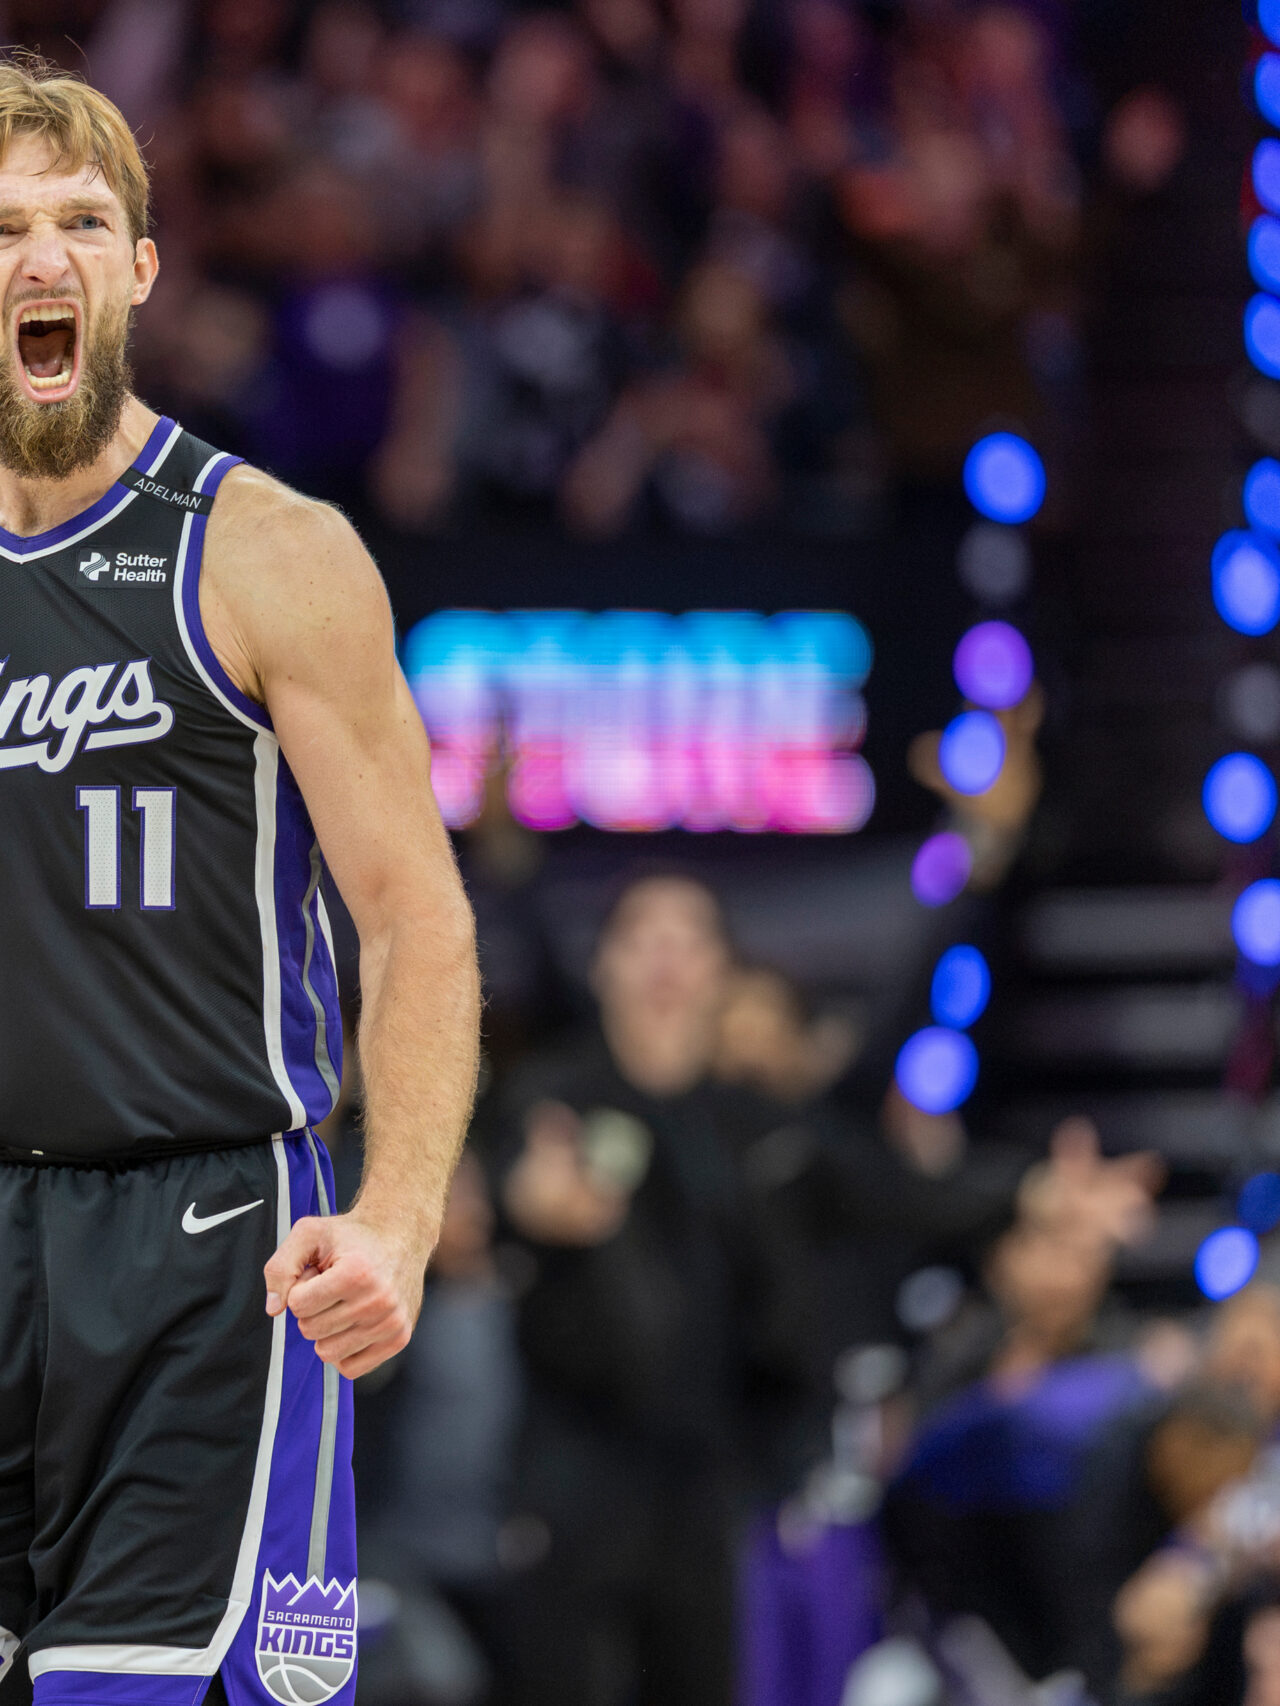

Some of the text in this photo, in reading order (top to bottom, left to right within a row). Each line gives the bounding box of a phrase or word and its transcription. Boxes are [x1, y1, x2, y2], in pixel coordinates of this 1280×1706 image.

[133, 477, 202, 509] ADELMAN
[115, 552, 167, 568] Sutter
[113, 568, 167, 583] Health
[75, 784, 177, 911] 11
[266, 1610, 353, 1628] SACRAMENTO
[259, 1625, 354, 1660] KINGS
